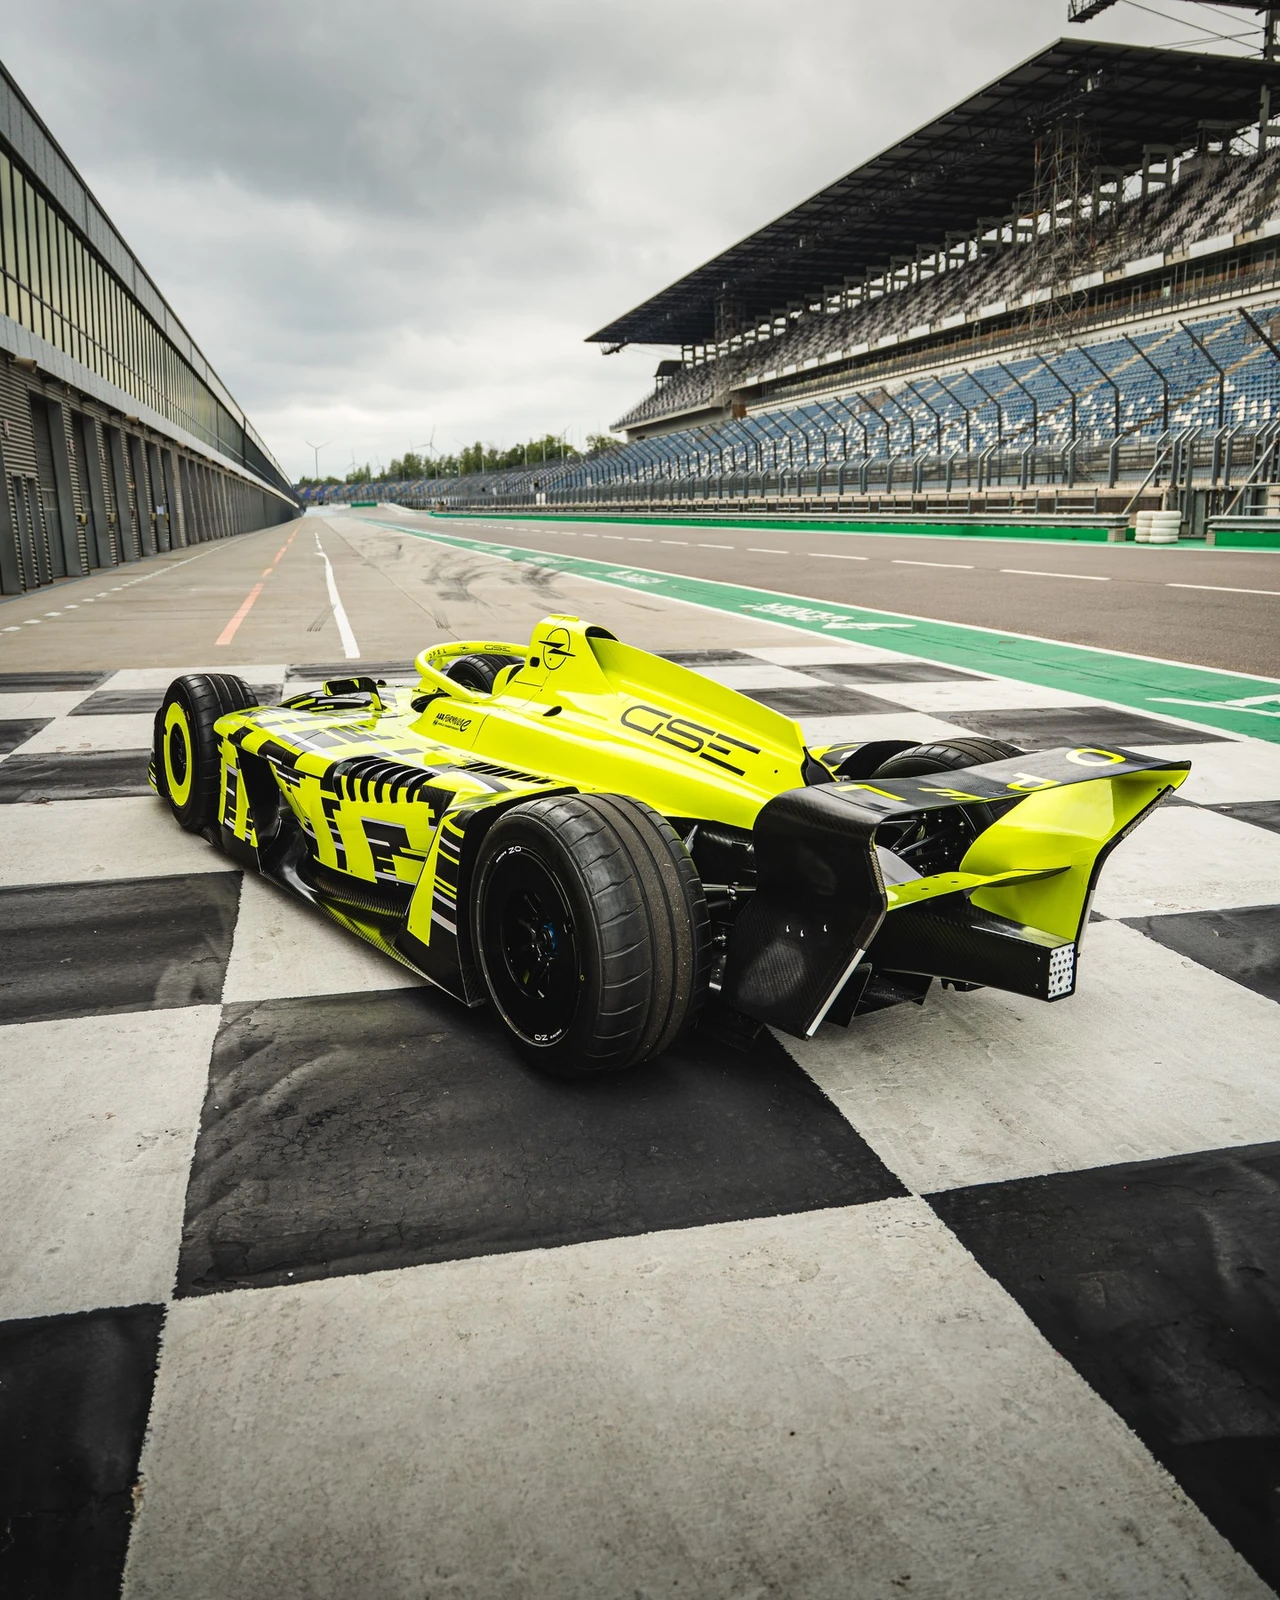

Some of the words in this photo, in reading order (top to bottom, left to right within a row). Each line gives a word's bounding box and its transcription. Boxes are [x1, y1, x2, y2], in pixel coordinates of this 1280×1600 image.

[428, 648, 447, 659] OPEL
[484, 644, 511, 652] GSE
[620, 704, 761, 777] GSE
[834, 748, 1126, 802] OPEL
